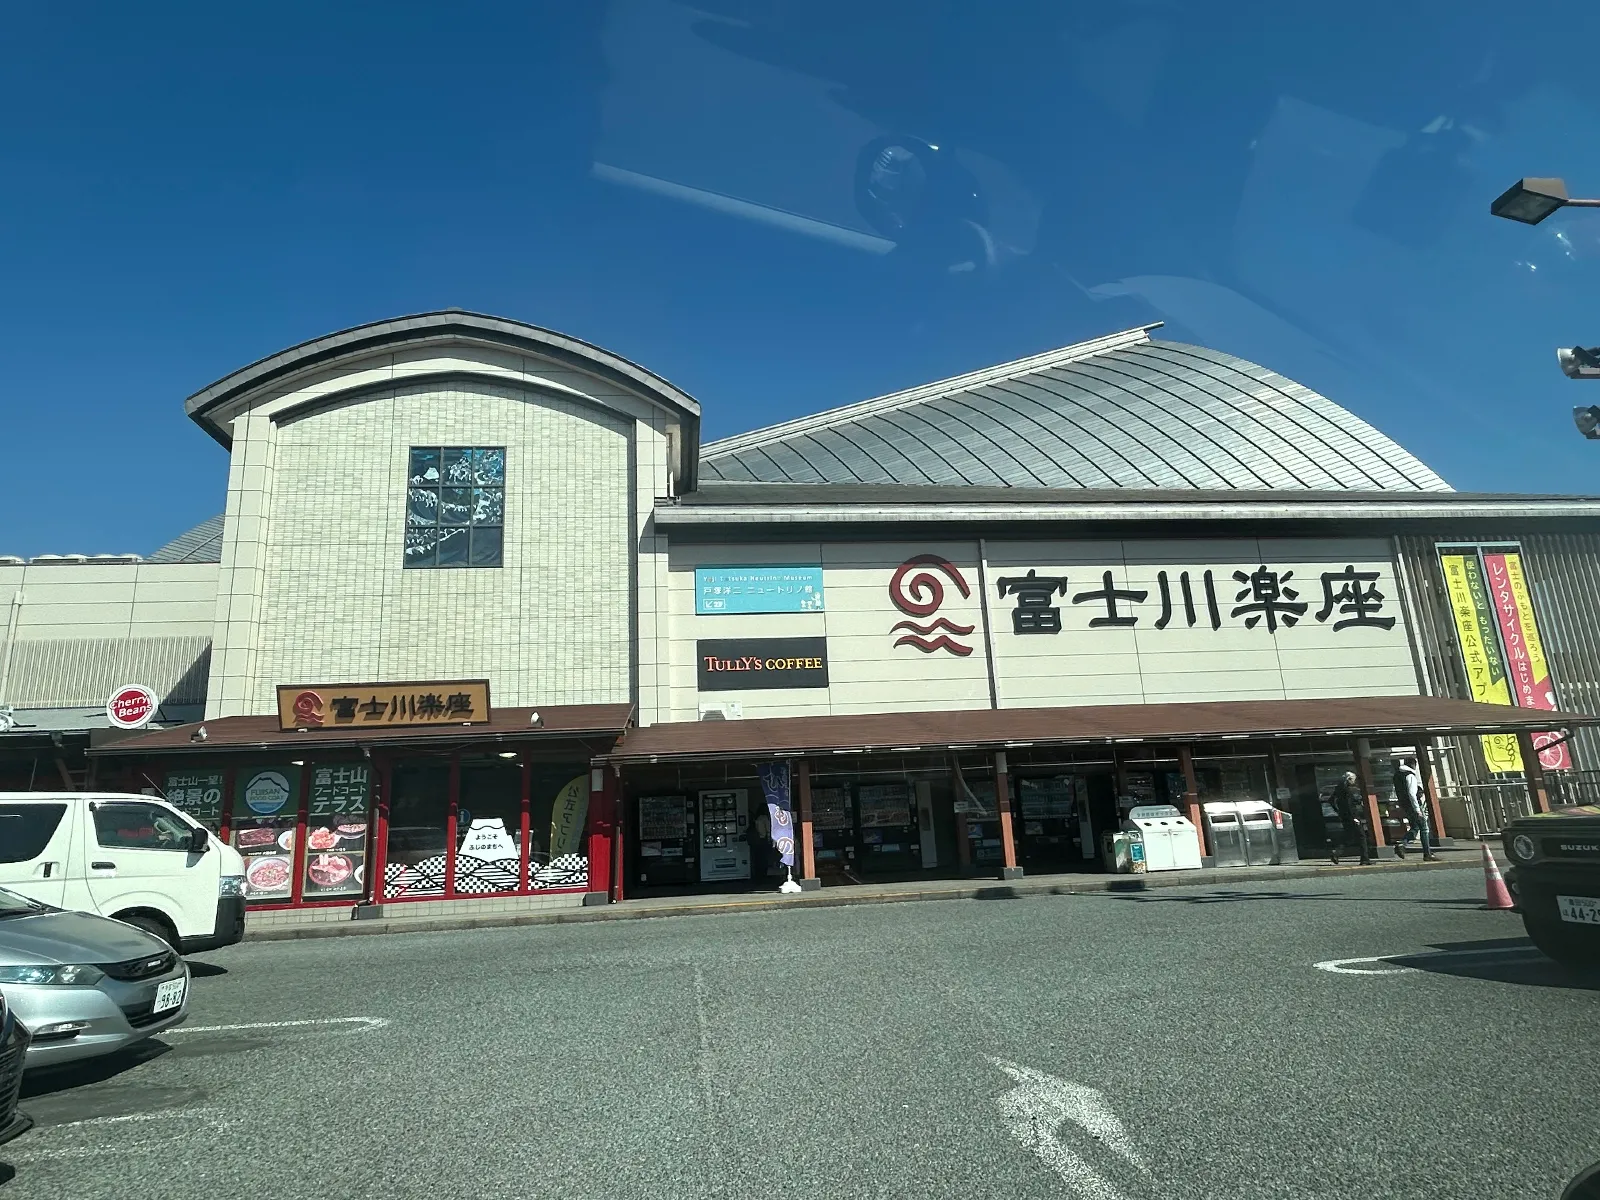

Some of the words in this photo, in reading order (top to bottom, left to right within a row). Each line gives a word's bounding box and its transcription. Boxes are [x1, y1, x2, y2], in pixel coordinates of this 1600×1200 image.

[747, 585, 813, 595] ニュートリノ館
[996, 565, 1396, 635] 富士川楽座
[1465, 560, 1485, 610] 使わないと
[1480, 616, 1500, 676] もったいない
[1448, 564, 1488, 704] 富士川楽座公式アプ
[1492, 562, 1536, 708] レンタサイクルはじめま
[765, 657, 823, 670] COFFEE
[110, 695, 149, 710] Cherry
[118, 704, 152, 717] Beans
[330, 691, 474, 723] 富士川楽座
[315, 766, 368, 785] 富士山
[166, 788, 221, 806] 絶景の
[314, 785, 367, 796] フードコート
[313, 795, 365, 813] テラス
[475, 833, 498, 841] ようこそ
[468, 843, 504, 851] ふじのまちへ
